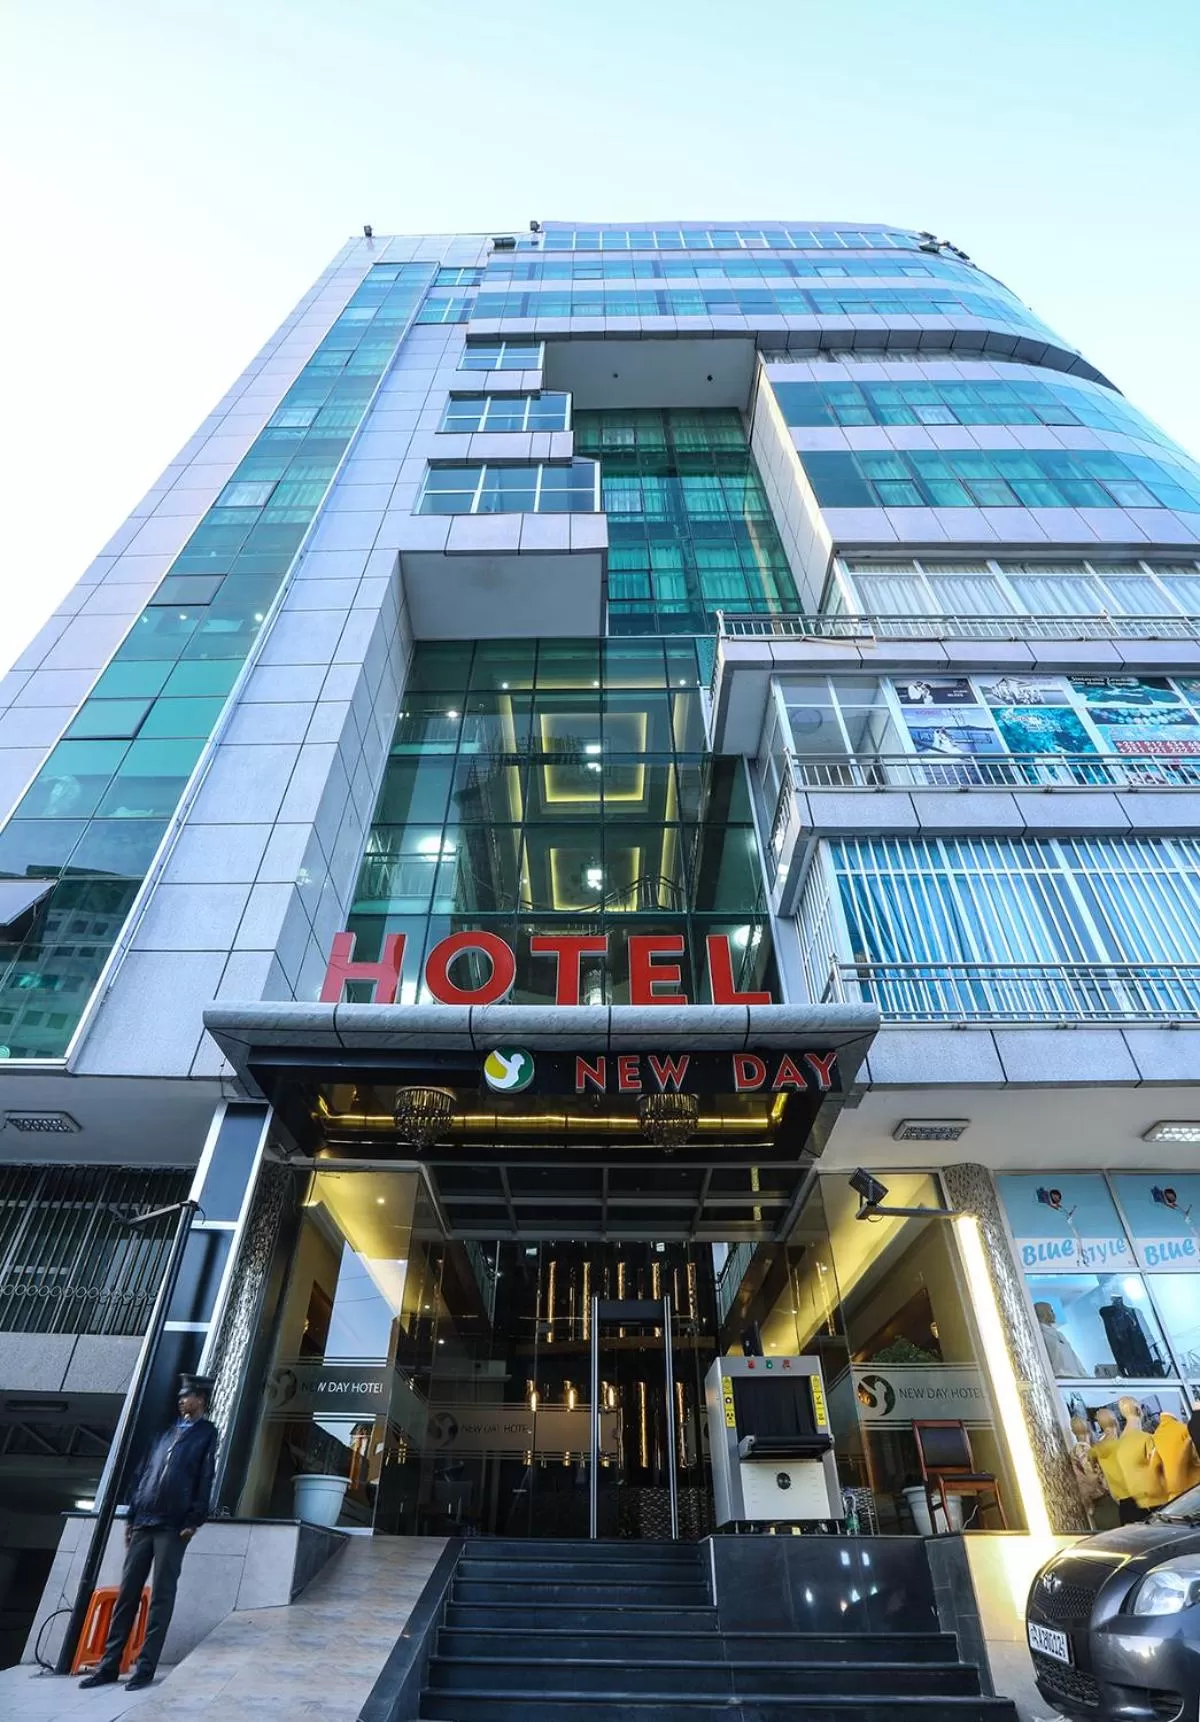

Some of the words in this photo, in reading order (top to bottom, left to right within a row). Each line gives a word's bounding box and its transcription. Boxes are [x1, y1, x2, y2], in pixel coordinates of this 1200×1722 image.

[319, 931, 771, 1005] HOTEL
[575, 1055, 690, 1092] NEW
[732, 1053, 838, 1092] DAY
[328, 1381, 350, 1393] DAY
[899, 1388, 924, 1399] NEW
[927, 1388, 948, 1399] DAY
[951, 1388, 986, 1399] HOTEL
